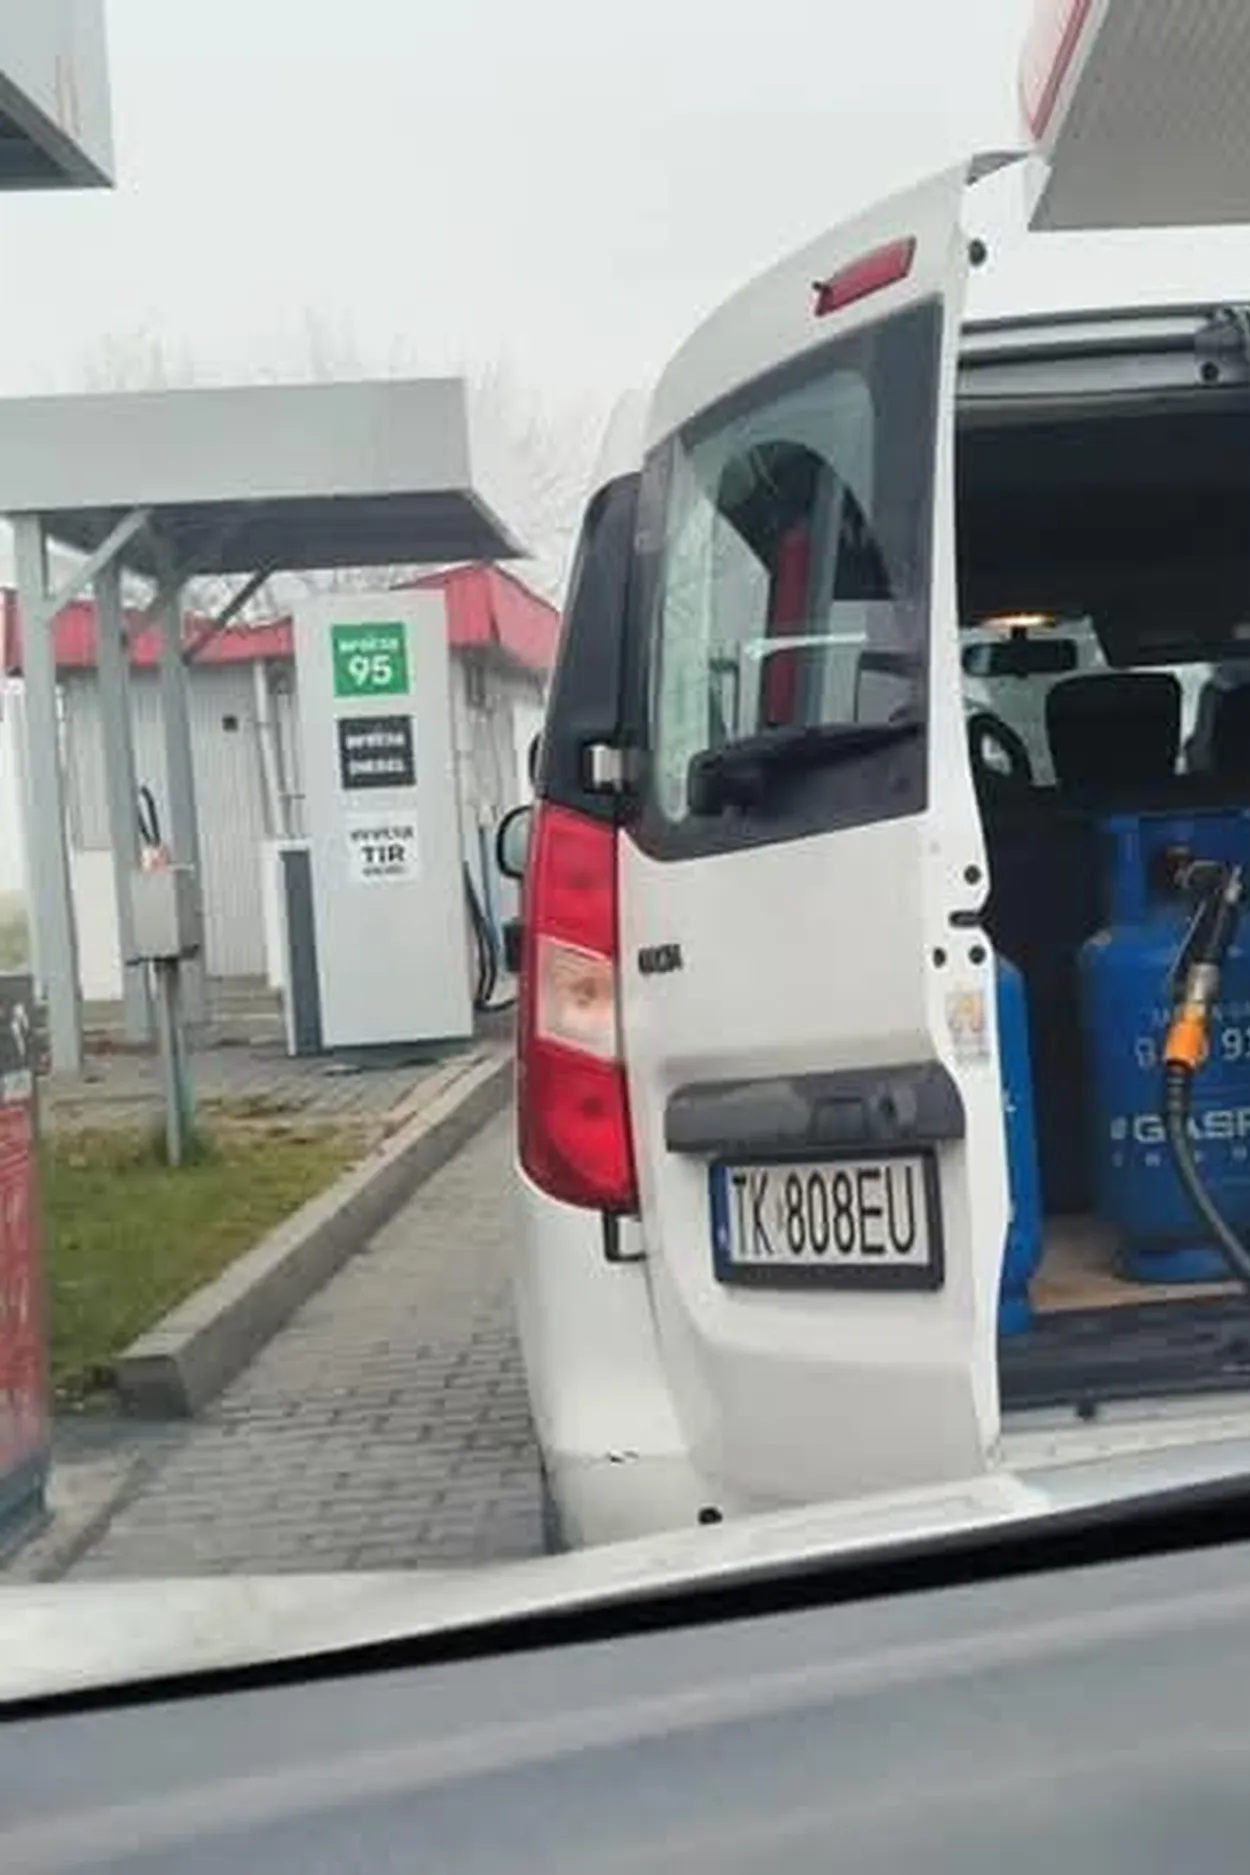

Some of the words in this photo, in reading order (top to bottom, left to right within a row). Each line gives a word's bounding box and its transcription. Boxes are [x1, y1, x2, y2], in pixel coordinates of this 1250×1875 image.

[348, 655, 394, 684] 95
[361, 845, 405, 864] TIR
[732, 1170, 774, 1255] TK
[784, 1165, 917, 1256] 808EU
